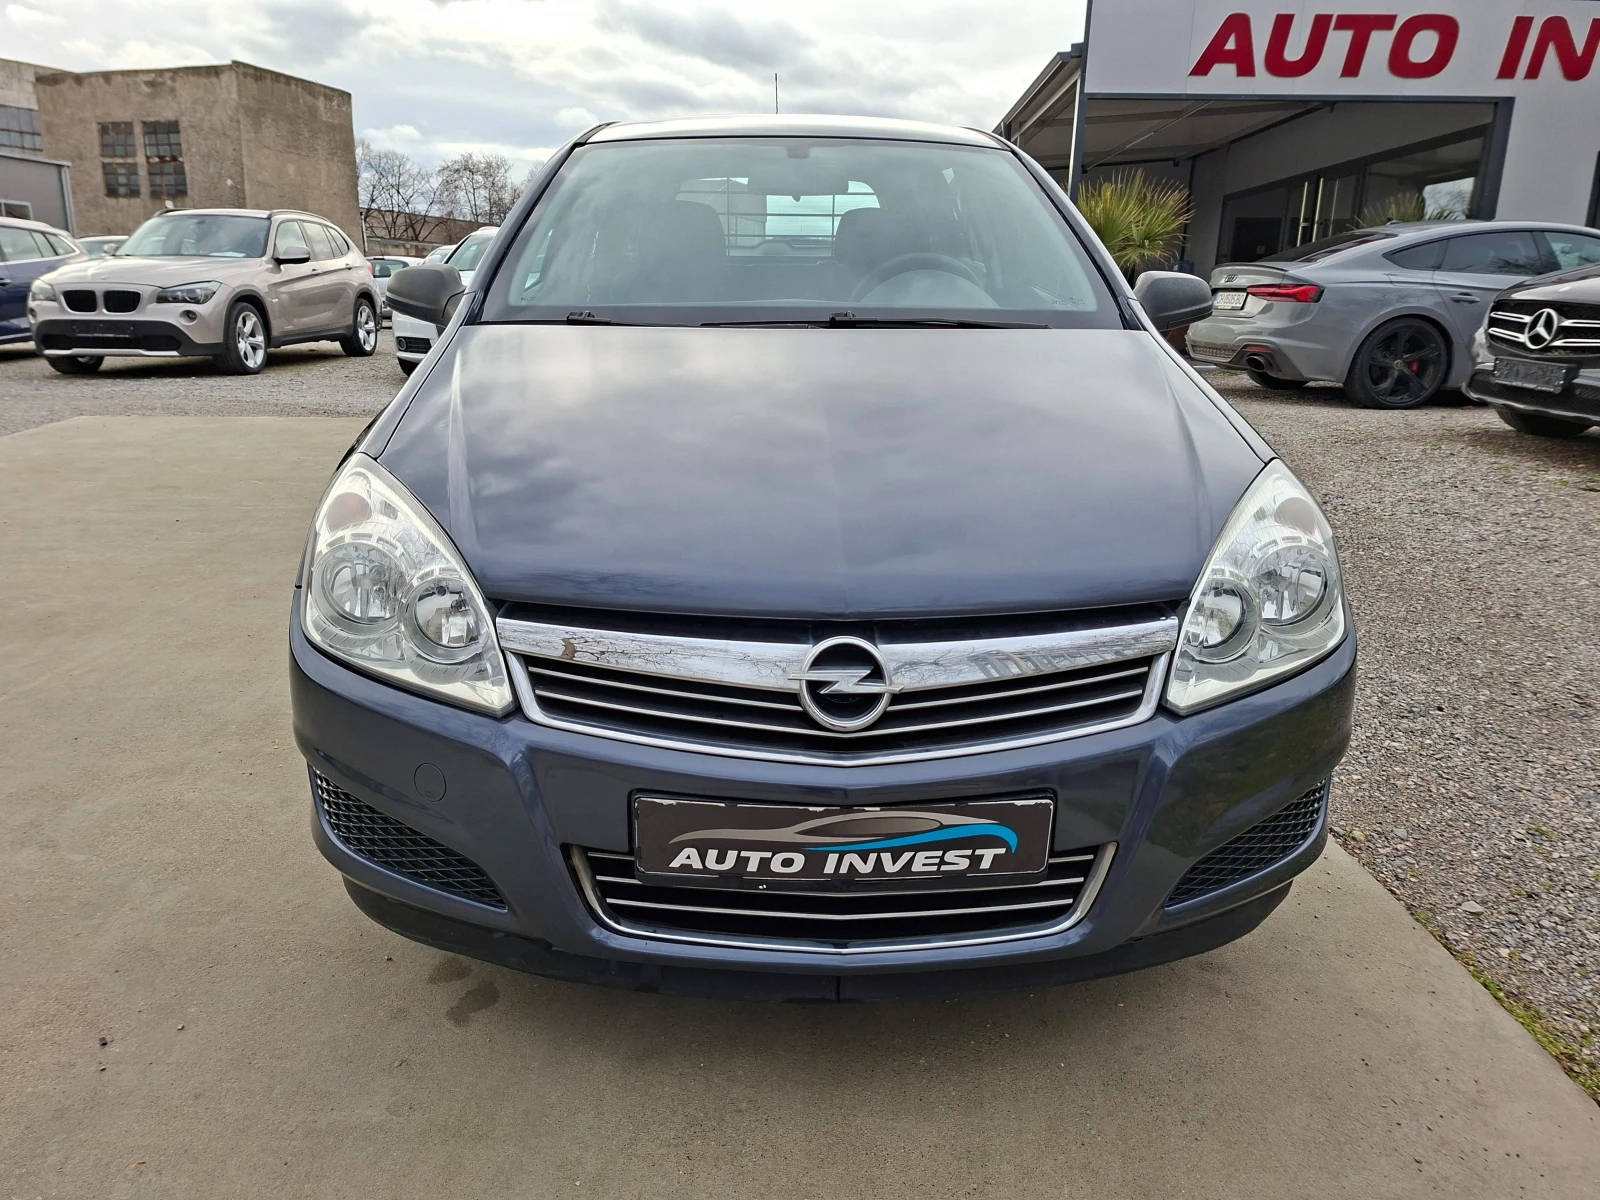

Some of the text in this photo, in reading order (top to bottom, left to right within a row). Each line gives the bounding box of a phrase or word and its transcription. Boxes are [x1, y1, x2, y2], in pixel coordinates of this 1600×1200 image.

[1187, 12, 1459, 79] AUTO
[668, 847, 1006, 874] AUTO INVEST
